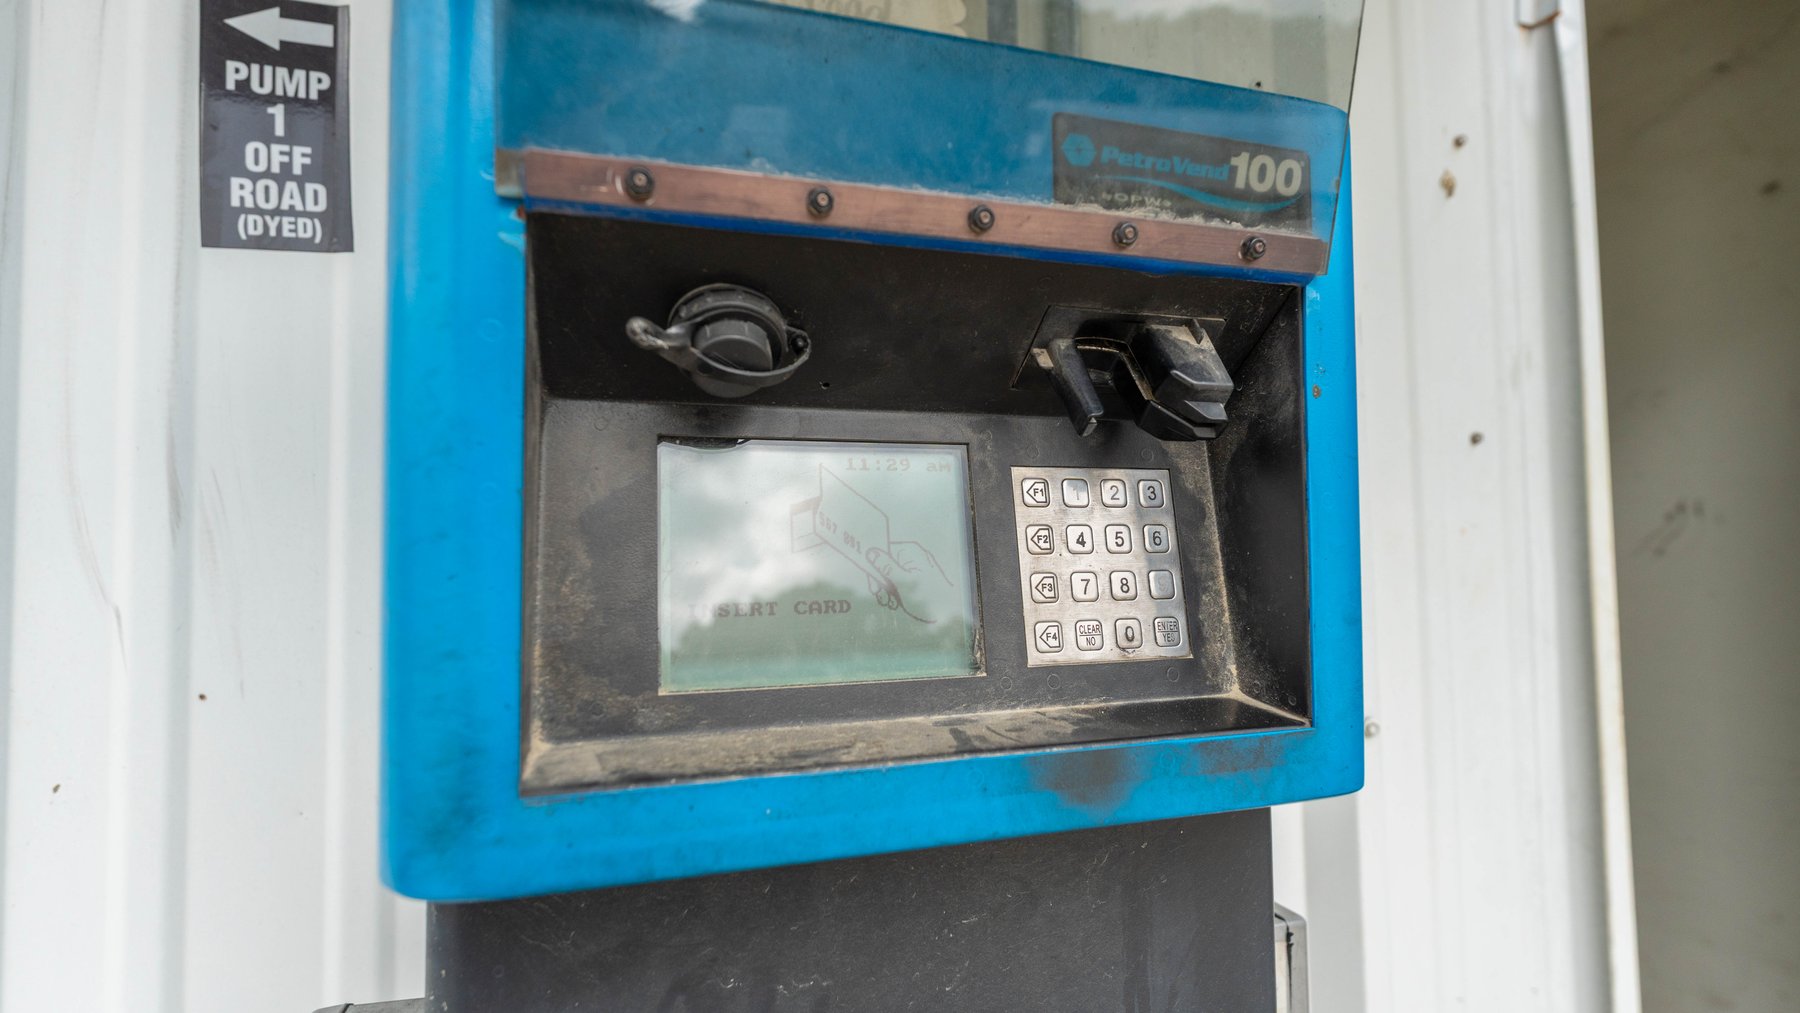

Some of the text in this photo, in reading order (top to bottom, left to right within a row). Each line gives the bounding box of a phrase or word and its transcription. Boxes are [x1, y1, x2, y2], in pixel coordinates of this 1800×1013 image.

[225, 60, 331, 100] PUMP
[266, 103, 285, 137] 1
[245, 141, 312, 175] OFF
[1101, 146, 1302, 197] PetroVend 100
[230, 176, 328, 213] ROAD
[237, 213, 323, 244] (DYED)
[845, 457, 911, 472] 11:29
[1033, 487, 1045, 497] F1
[1110, 485, 1120, 501] 2
[1147, 486, 1157, 501] 3
[1037, 534, 1049, 544] F2
[1076, 532, 1087, 548] 4
[1114, 531, 1125, 547] 5
[1152, 531, 1162, 546] 6
[1041, 583, 1053, 592] F3
[1080, 579, 1091, 595] 7
[1120, 577, 1130, 594] 8
[687, 599, 852, 623] ISERT CARD
[1079, 624, 1101, 635] CLEAR
[1125, 625, 1135, 642] 0
[1157, 621, 1178, 631] ENTER
[1046, 631, 1058, 641] F4
[1086, 637, 1096, 646] NO
[1163, 633, 1176, 643] YES
